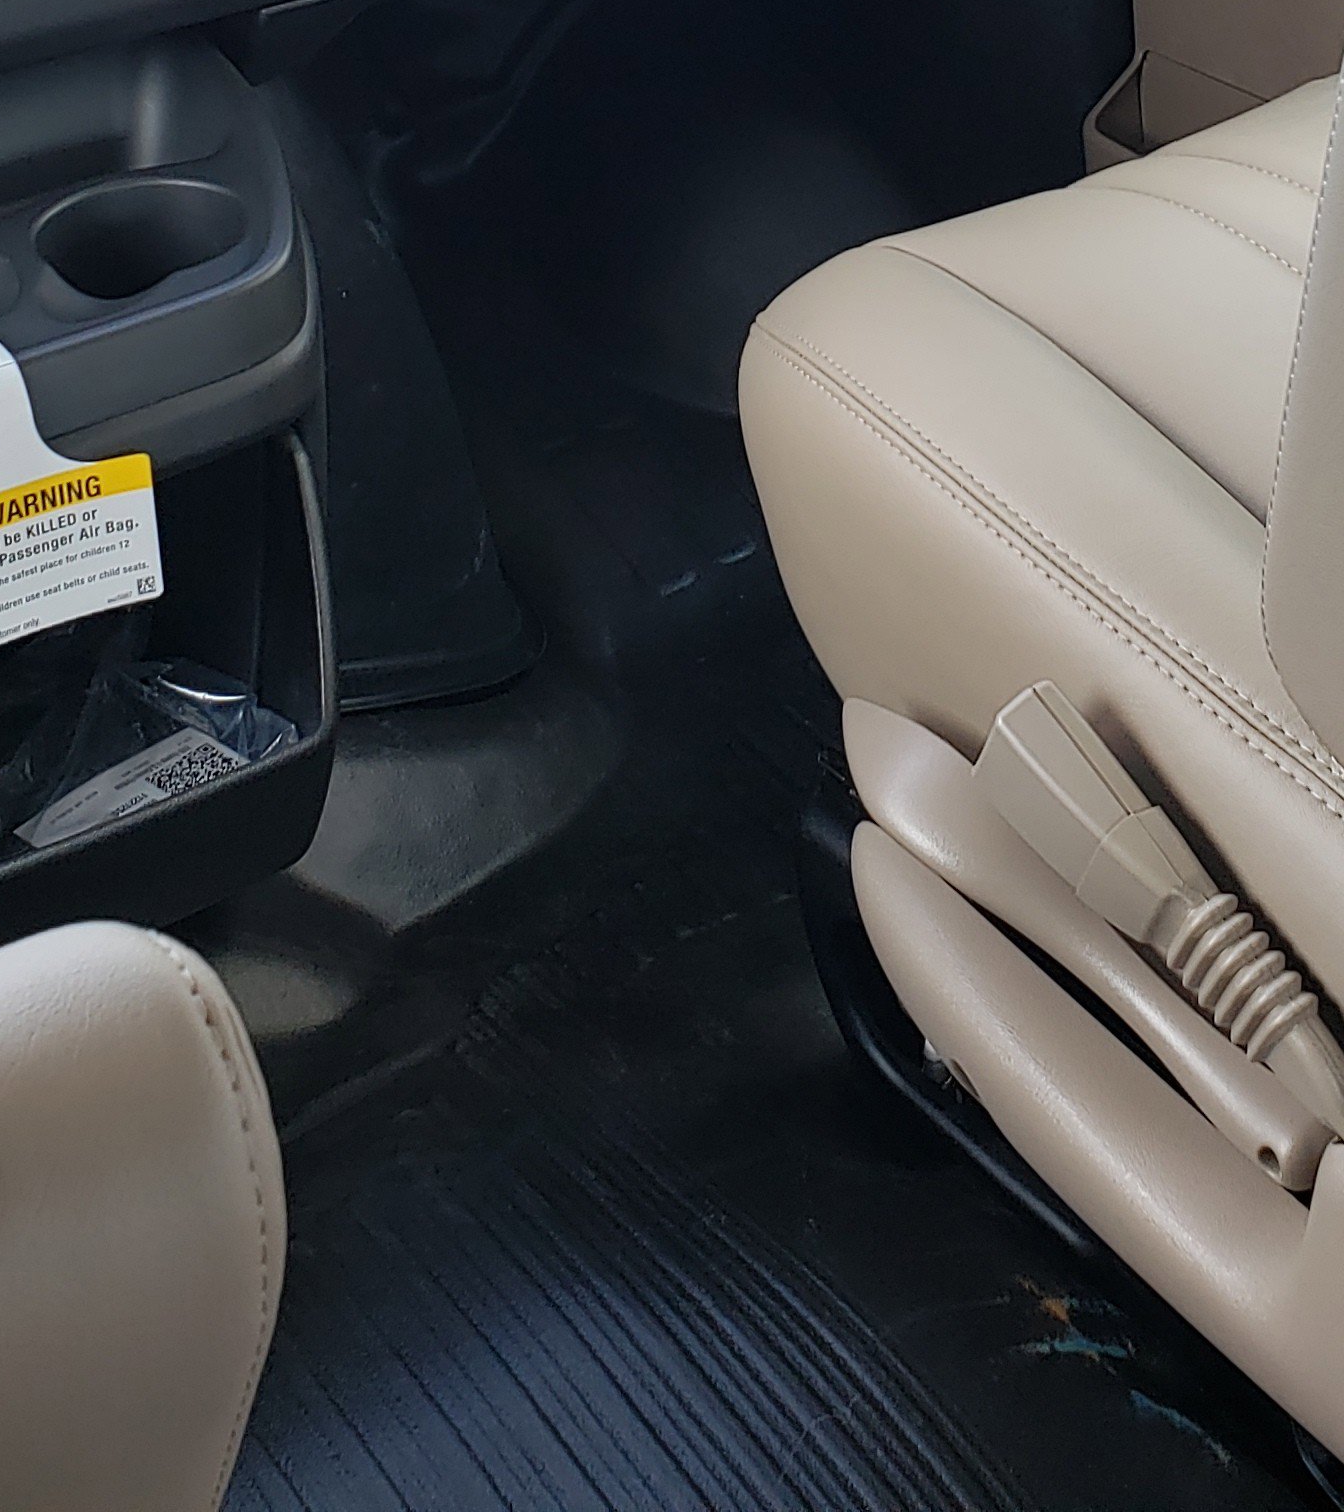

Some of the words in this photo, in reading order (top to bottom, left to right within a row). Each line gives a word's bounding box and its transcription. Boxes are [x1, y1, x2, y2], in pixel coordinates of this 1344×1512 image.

[0, 532, 74, 567] Passenger
[79, 524, 101, 542] Air
[105, 517, 140, 536] Bag.
[4, 529, 22, 547] be
[26, 513, 77, 540] KILLED
[82, 508, 98, 523] or
[12, 566, 38, 581] safest
[40, 559, 64, 574] place
[66, 552, 78, 564] for
[80, 544, 116, 560] children
[118, 540, 130, 550] 12
[25, 592, 42, 604] use
[43, 584, 62, 598] seat
[64, 576, 86, 591] belts
[88, 574, 97, 584] or
[99, 568, 121, 580] child
[122, 561, 150, 575] seats.
